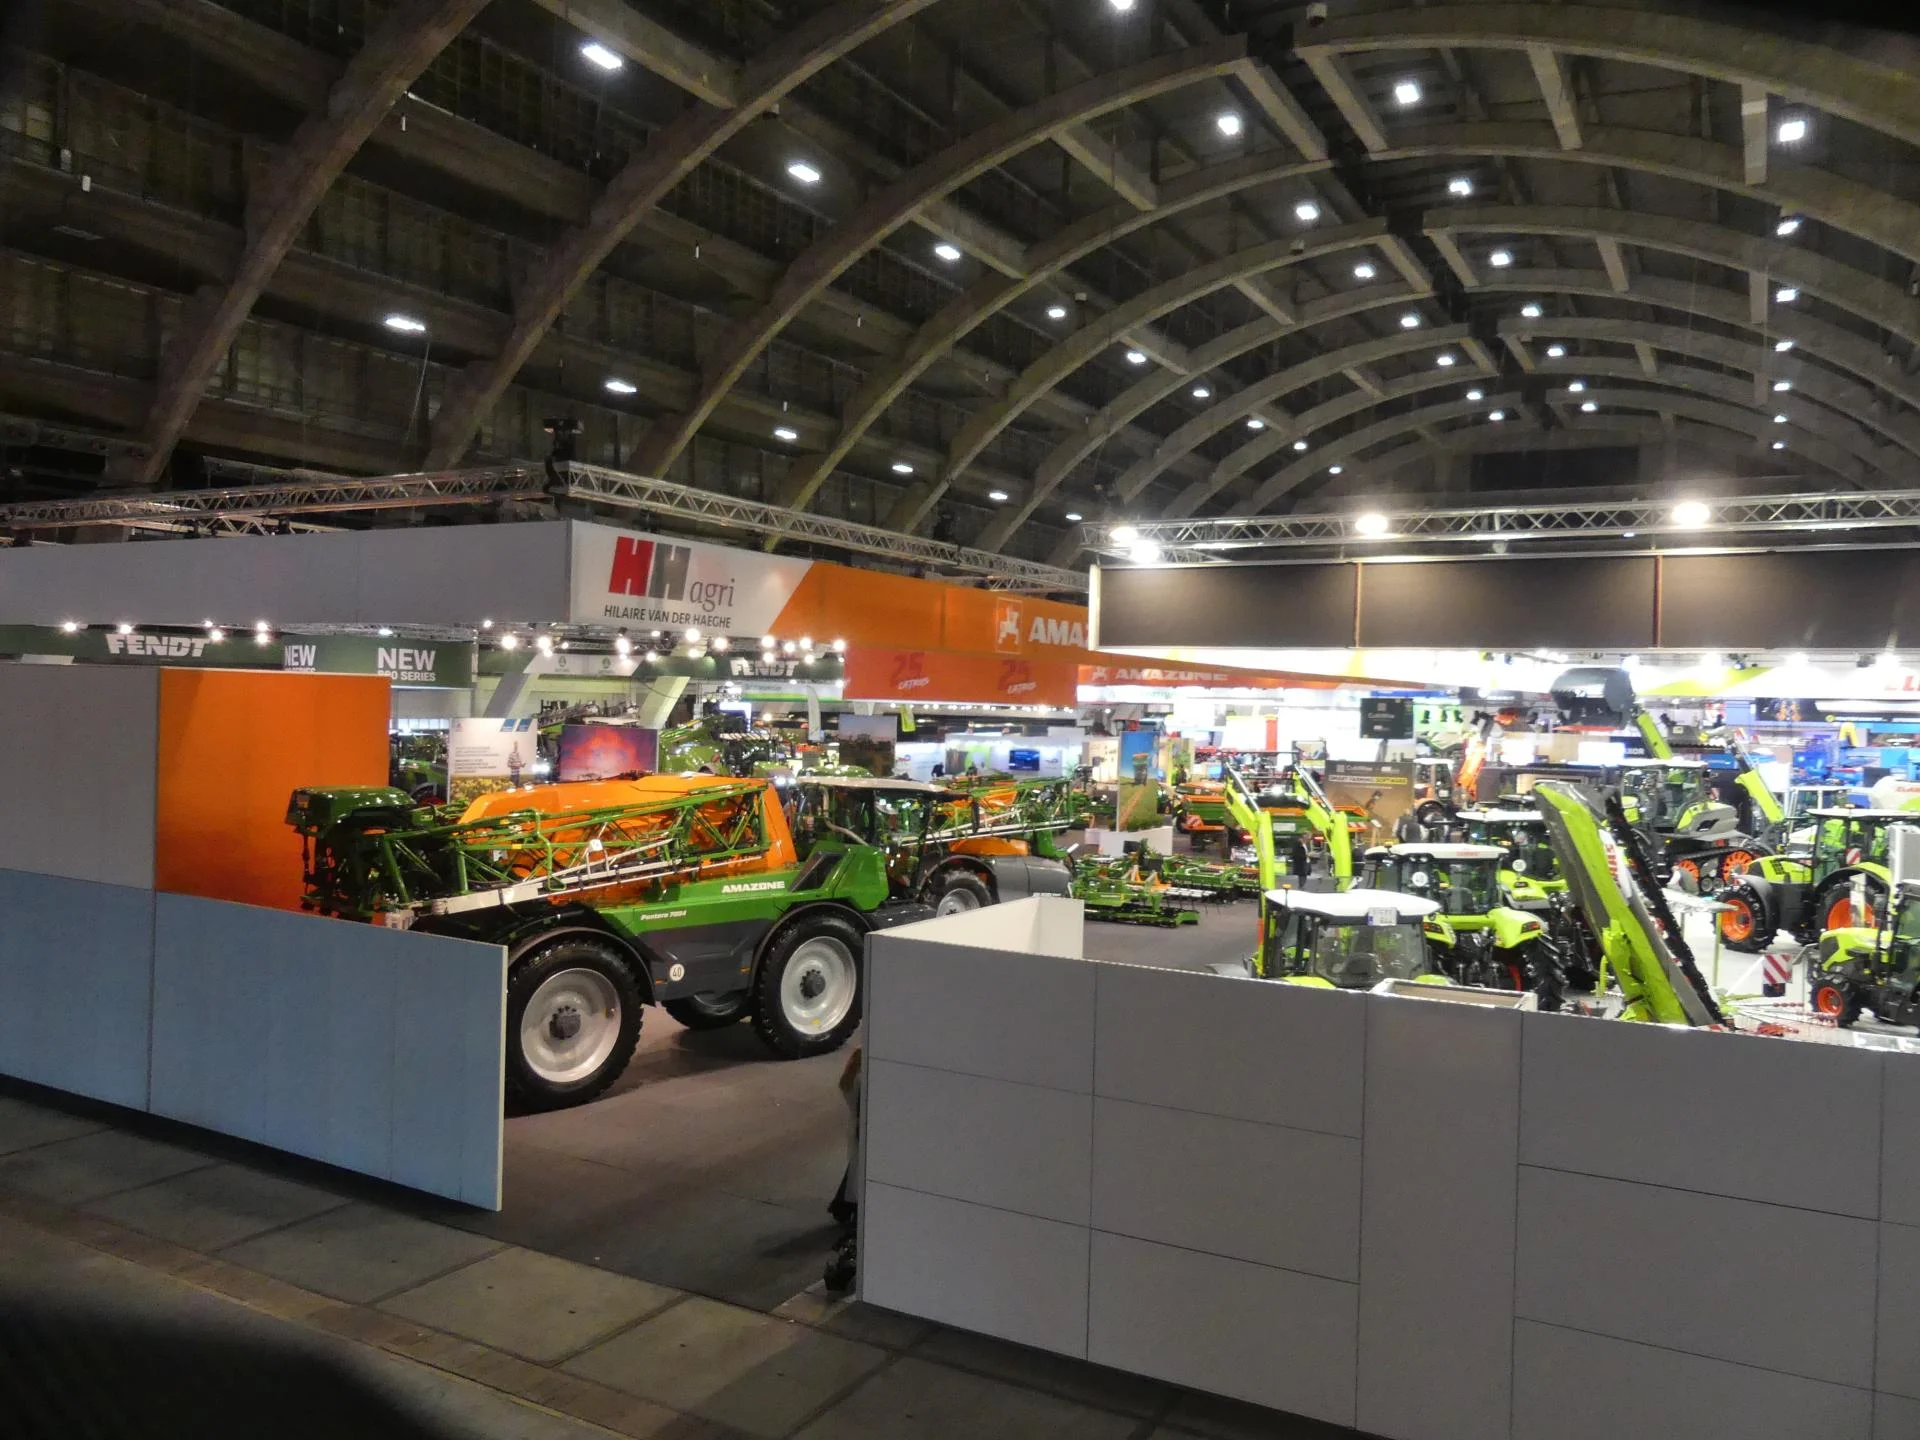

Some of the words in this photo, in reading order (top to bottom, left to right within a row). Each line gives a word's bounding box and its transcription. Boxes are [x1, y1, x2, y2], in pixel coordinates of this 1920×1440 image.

[690, 578, 736, 613] agri
[604, 605, 646, 621] HILAIRE
[649, 610, 670, 623] VAN
[671, 612, 691, 625] DER
[693, 615, 731, 629] HAEGHE
[1028, 616, 1089, 648] AMA
[105, 633, 212, 657] FENDT
[284, 644, 317, 667] NEW
[377, 648, 436, 671] NEW
[729, 657, 799, 676] FENDT
[401, 671, 436, 682] SERIES
[1114, 667, 1229, 681] AMAZONE
[721, 881, 785, 893] AMAZONE
[672, 967, 682, 977] 40
